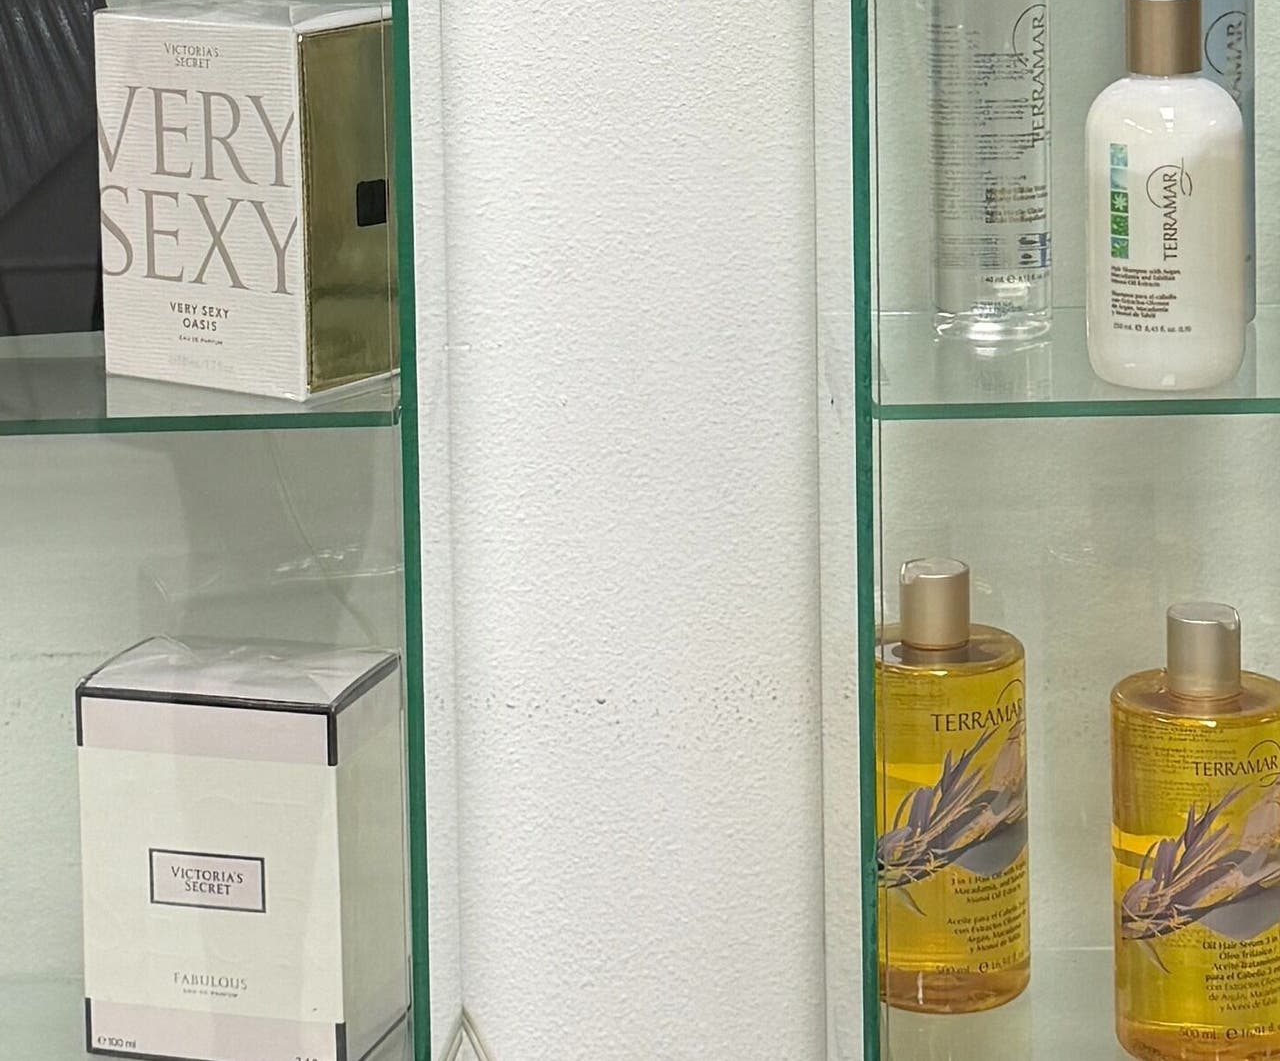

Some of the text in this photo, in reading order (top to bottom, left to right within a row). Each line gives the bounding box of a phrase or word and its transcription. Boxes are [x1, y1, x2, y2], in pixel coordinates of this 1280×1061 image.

[163, 42, 219, 58] VICTORIA'S
[174, 57, 211, 69] SECRET
[1032, 13, 1046, 147] TERRAMAR
[97, 85, 295, 188] VERY
[1163, 170, 1178, 261] TERRAMAR
[100, 184, 298, 296] SEXY
[169, 301, 229, 319] VERY SEXY
[182, 317, 217, 332] OASIS
[1193, 754, 1278, 777] TERRAMAR
[171, 866, 243, 884] VICTORIA'S
[185, 881, 232, 896] SECRET
[173, 971, 248, 991] FABULOUS
[108, 1037, 137, 1049] 100 ml
